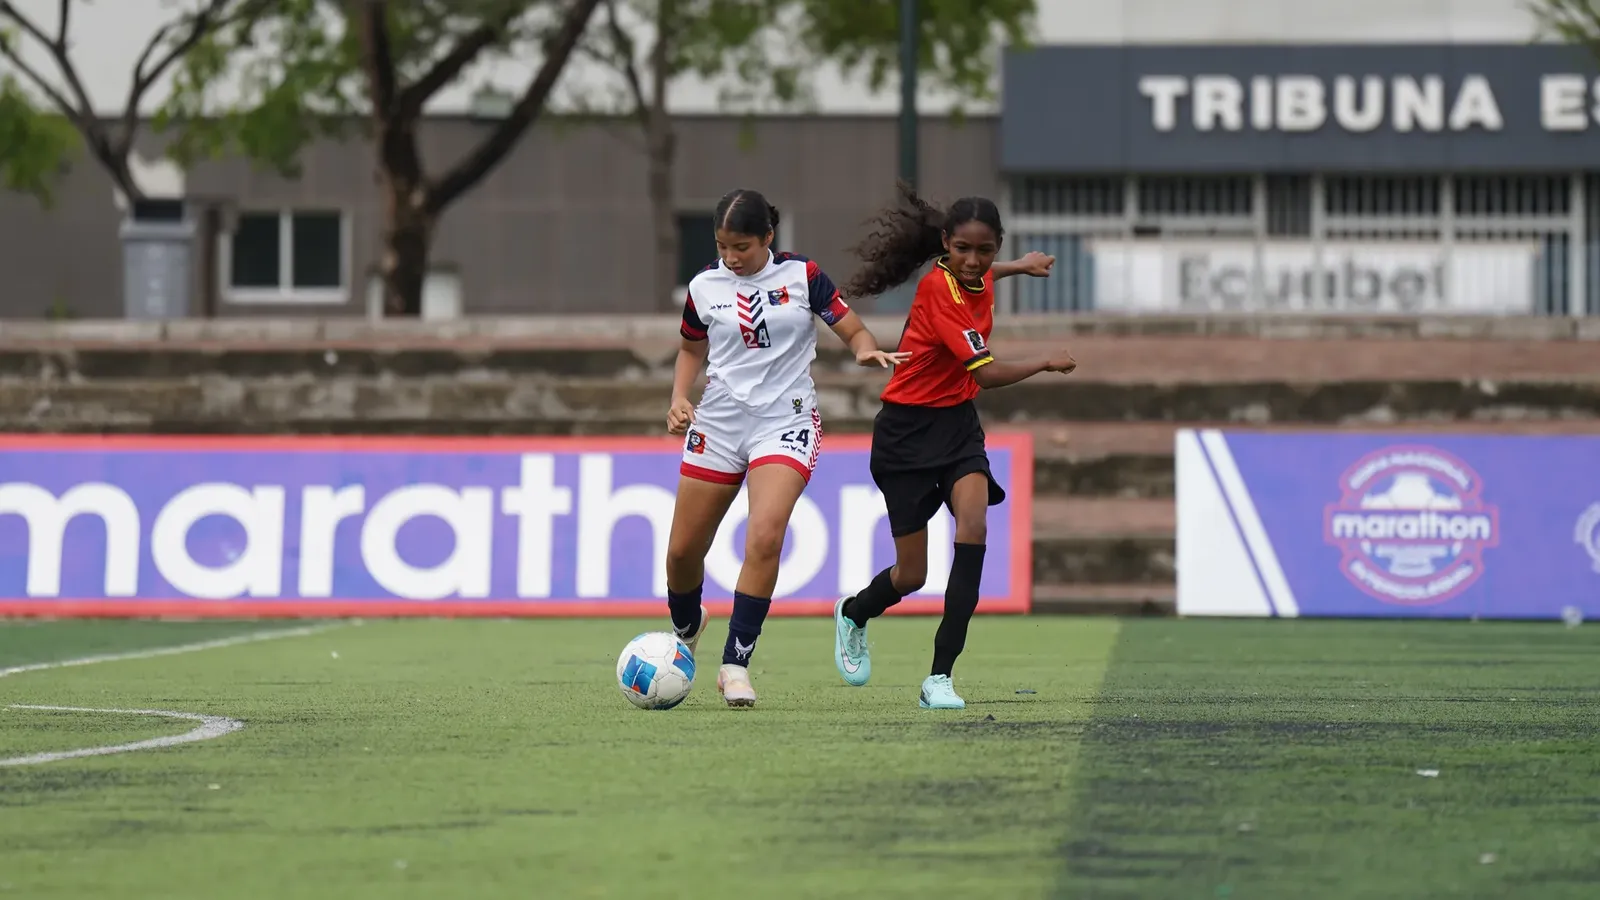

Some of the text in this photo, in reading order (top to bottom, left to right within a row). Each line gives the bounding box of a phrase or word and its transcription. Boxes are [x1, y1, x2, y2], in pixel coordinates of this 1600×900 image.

[1138, 73, 1600, 132] TRIBUNA E
[743, 328, 770, 348] 24
[780, 428, 810, 448] 24
[1332, 510, 1491, 540] marathon
